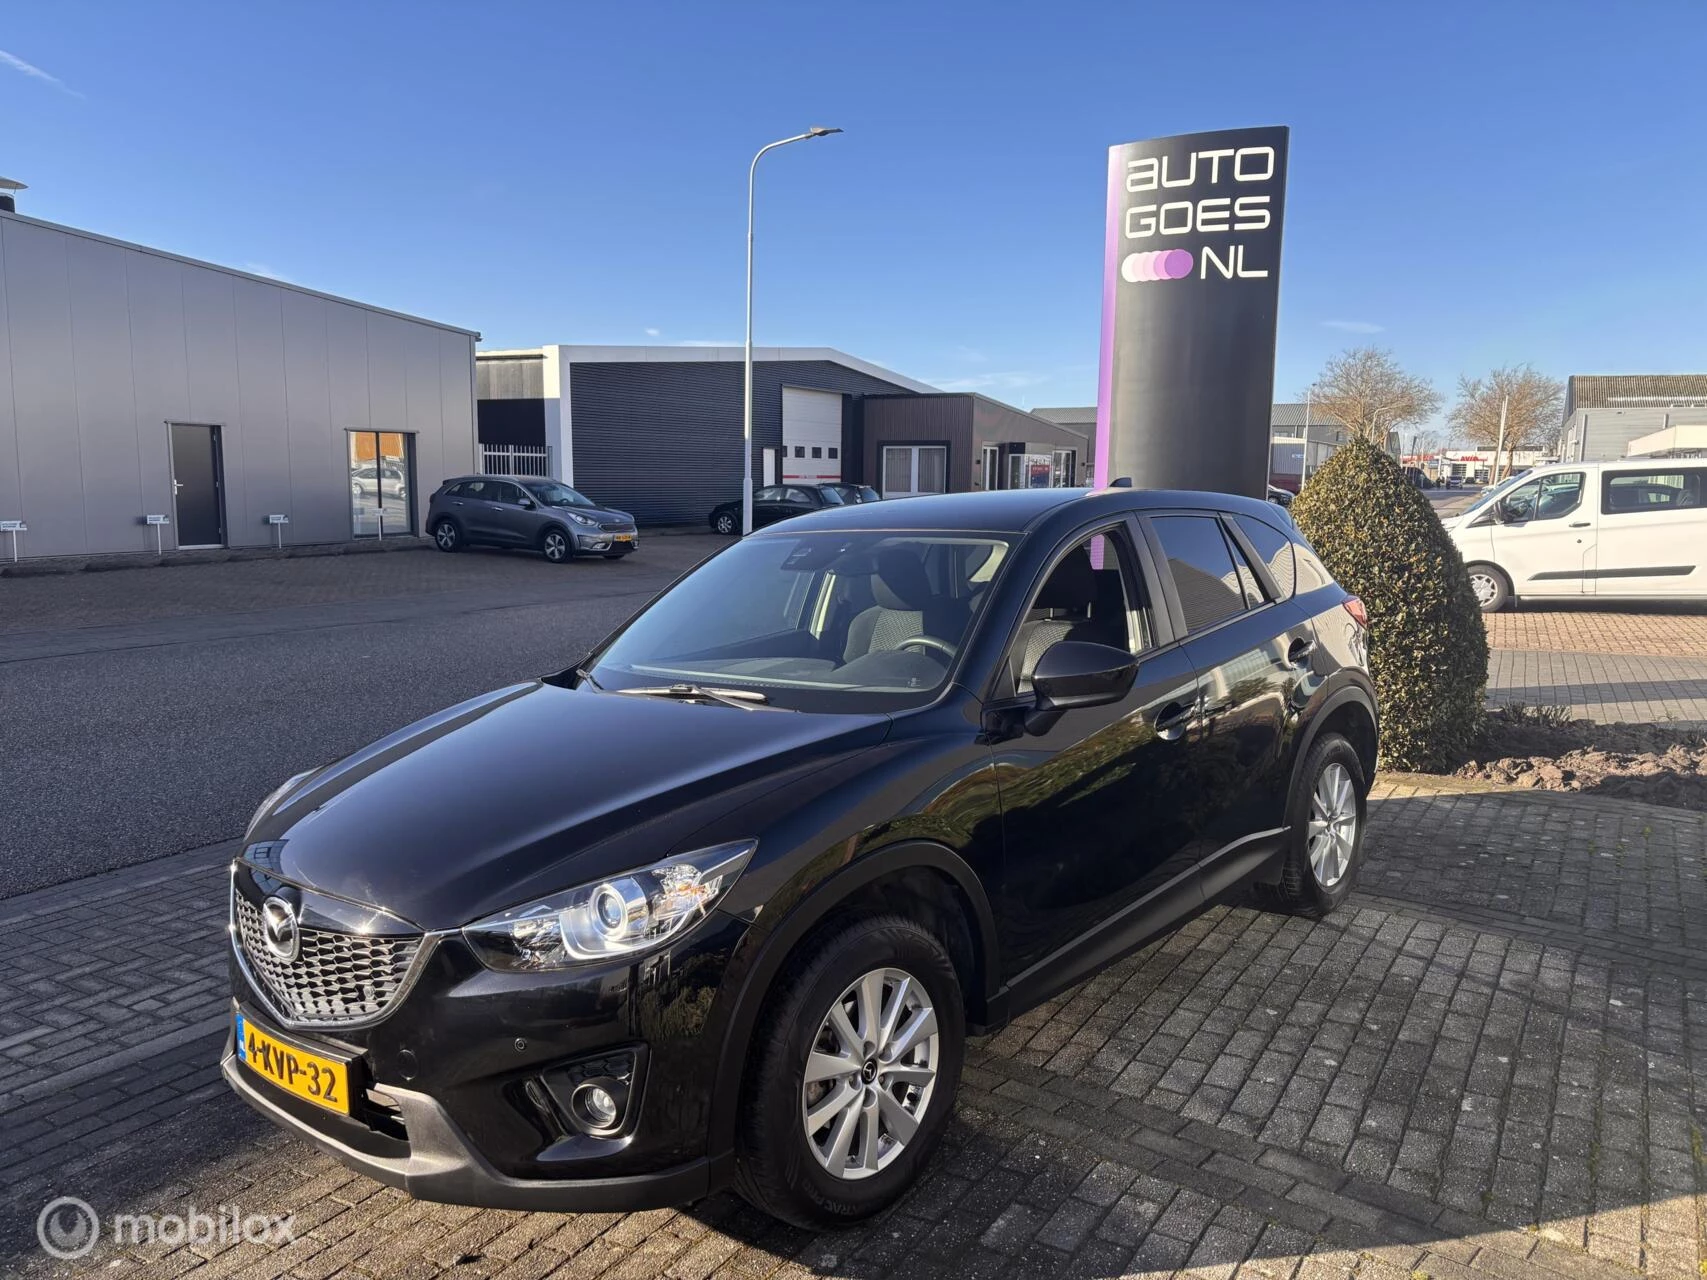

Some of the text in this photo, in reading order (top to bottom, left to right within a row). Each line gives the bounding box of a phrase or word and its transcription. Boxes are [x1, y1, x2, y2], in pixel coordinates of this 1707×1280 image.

[1125, 195, 1271, 239] GOES
[1200, 244, 1269, 280] NL
[247, 1031, 338, 1104] 4-KVP-32
